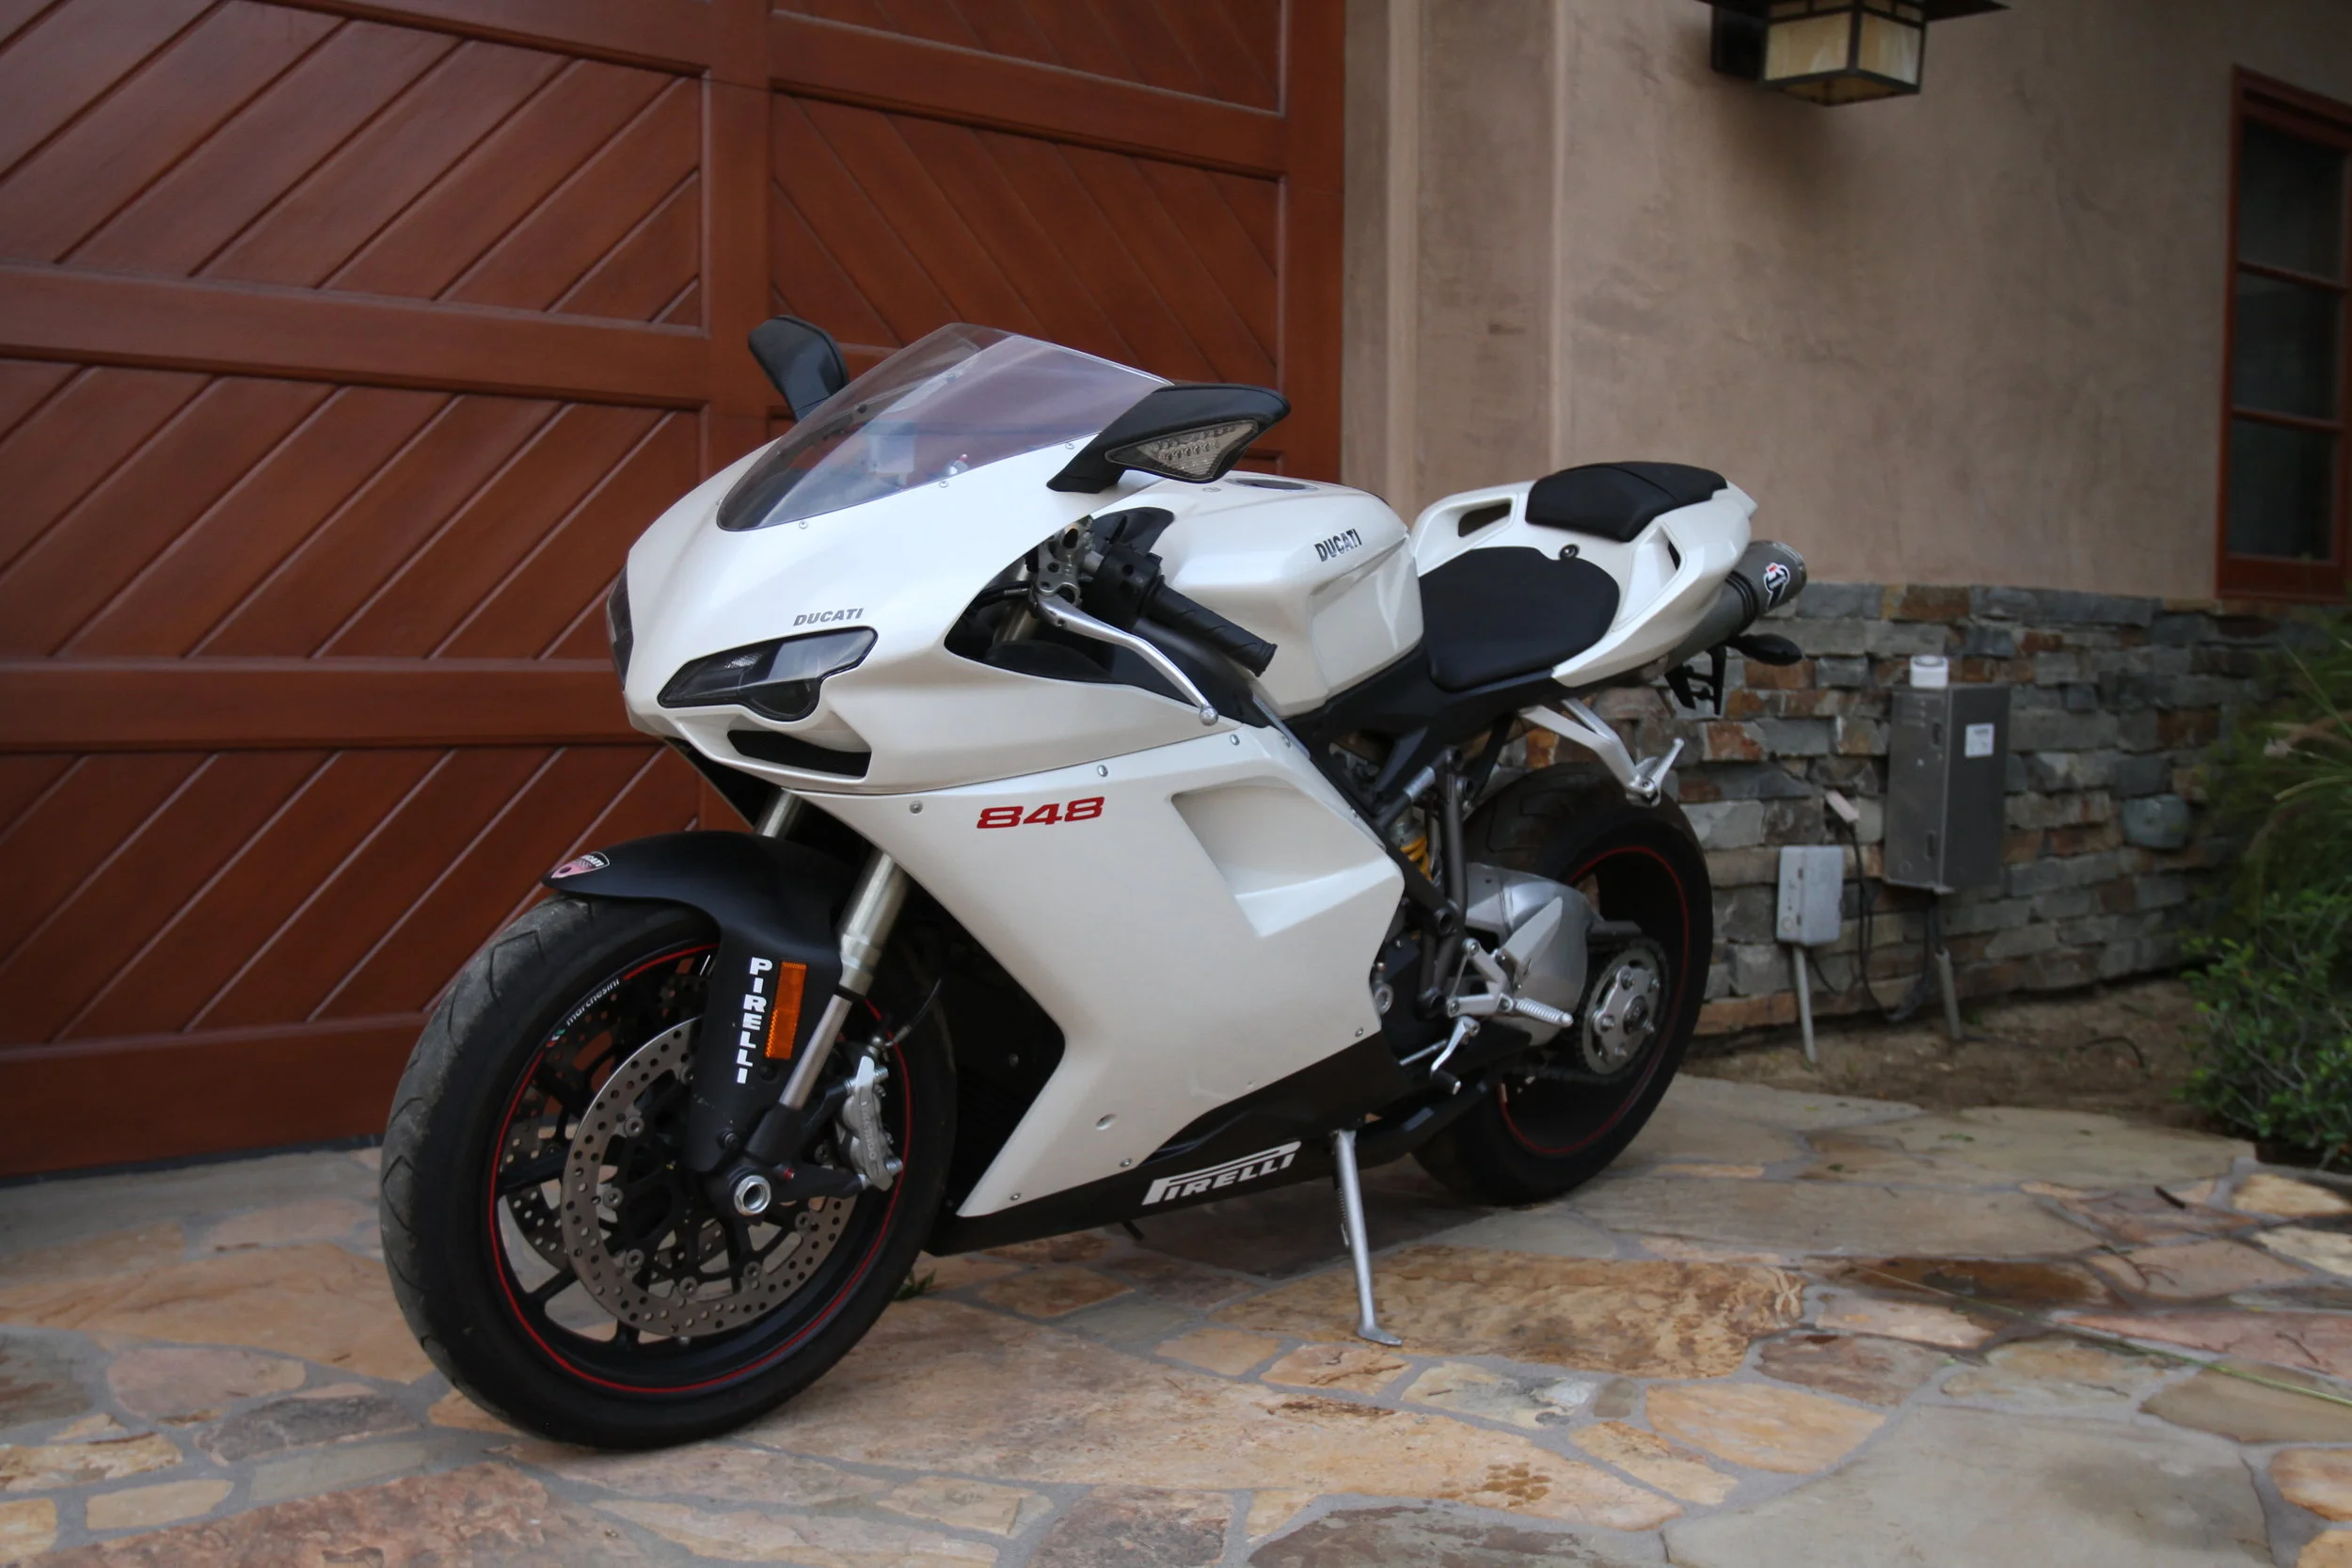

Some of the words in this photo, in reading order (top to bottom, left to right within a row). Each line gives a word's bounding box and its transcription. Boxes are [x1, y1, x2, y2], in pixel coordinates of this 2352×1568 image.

[1314, 528, 1362, 562] DUCATI
[793, 608, 864, 626] DUCATI
[977, 796, 1105, 829] 848
[566, 978, 620, 1026] marchesini
[737, 957, 773, 1084] PIRELLI
[1141, 1140, 1302, 1206] PIRELLI
